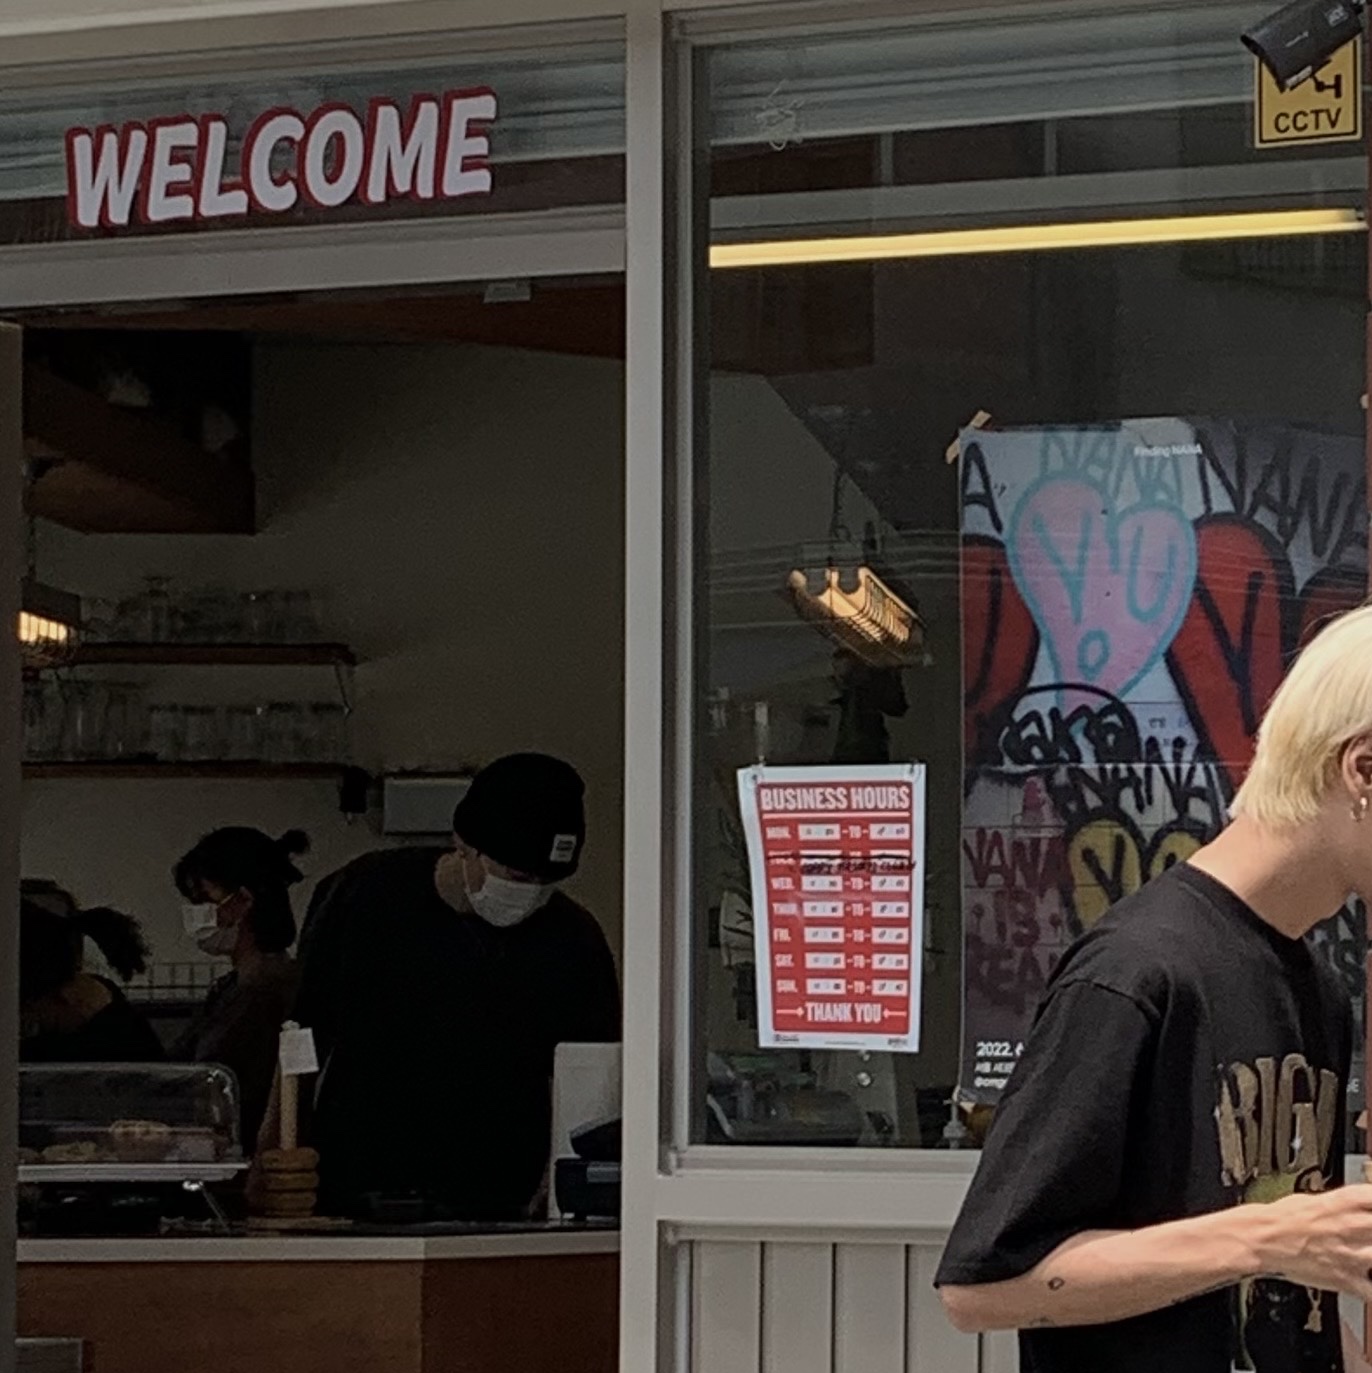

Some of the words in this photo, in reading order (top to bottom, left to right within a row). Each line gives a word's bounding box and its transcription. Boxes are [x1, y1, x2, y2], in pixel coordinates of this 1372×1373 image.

[1273, 107, 1342, 134] CCTV
[66, 87, 498, 230] WELCOME
[760, 786, 848, 811] BUSINESS
[851, 785, 911, 809] HOURS
[805, 1002, 853, 1022] THANK
[854, 1003, 882, 1023] YOU
[976, 1041, 1014, 1057] 2022.
